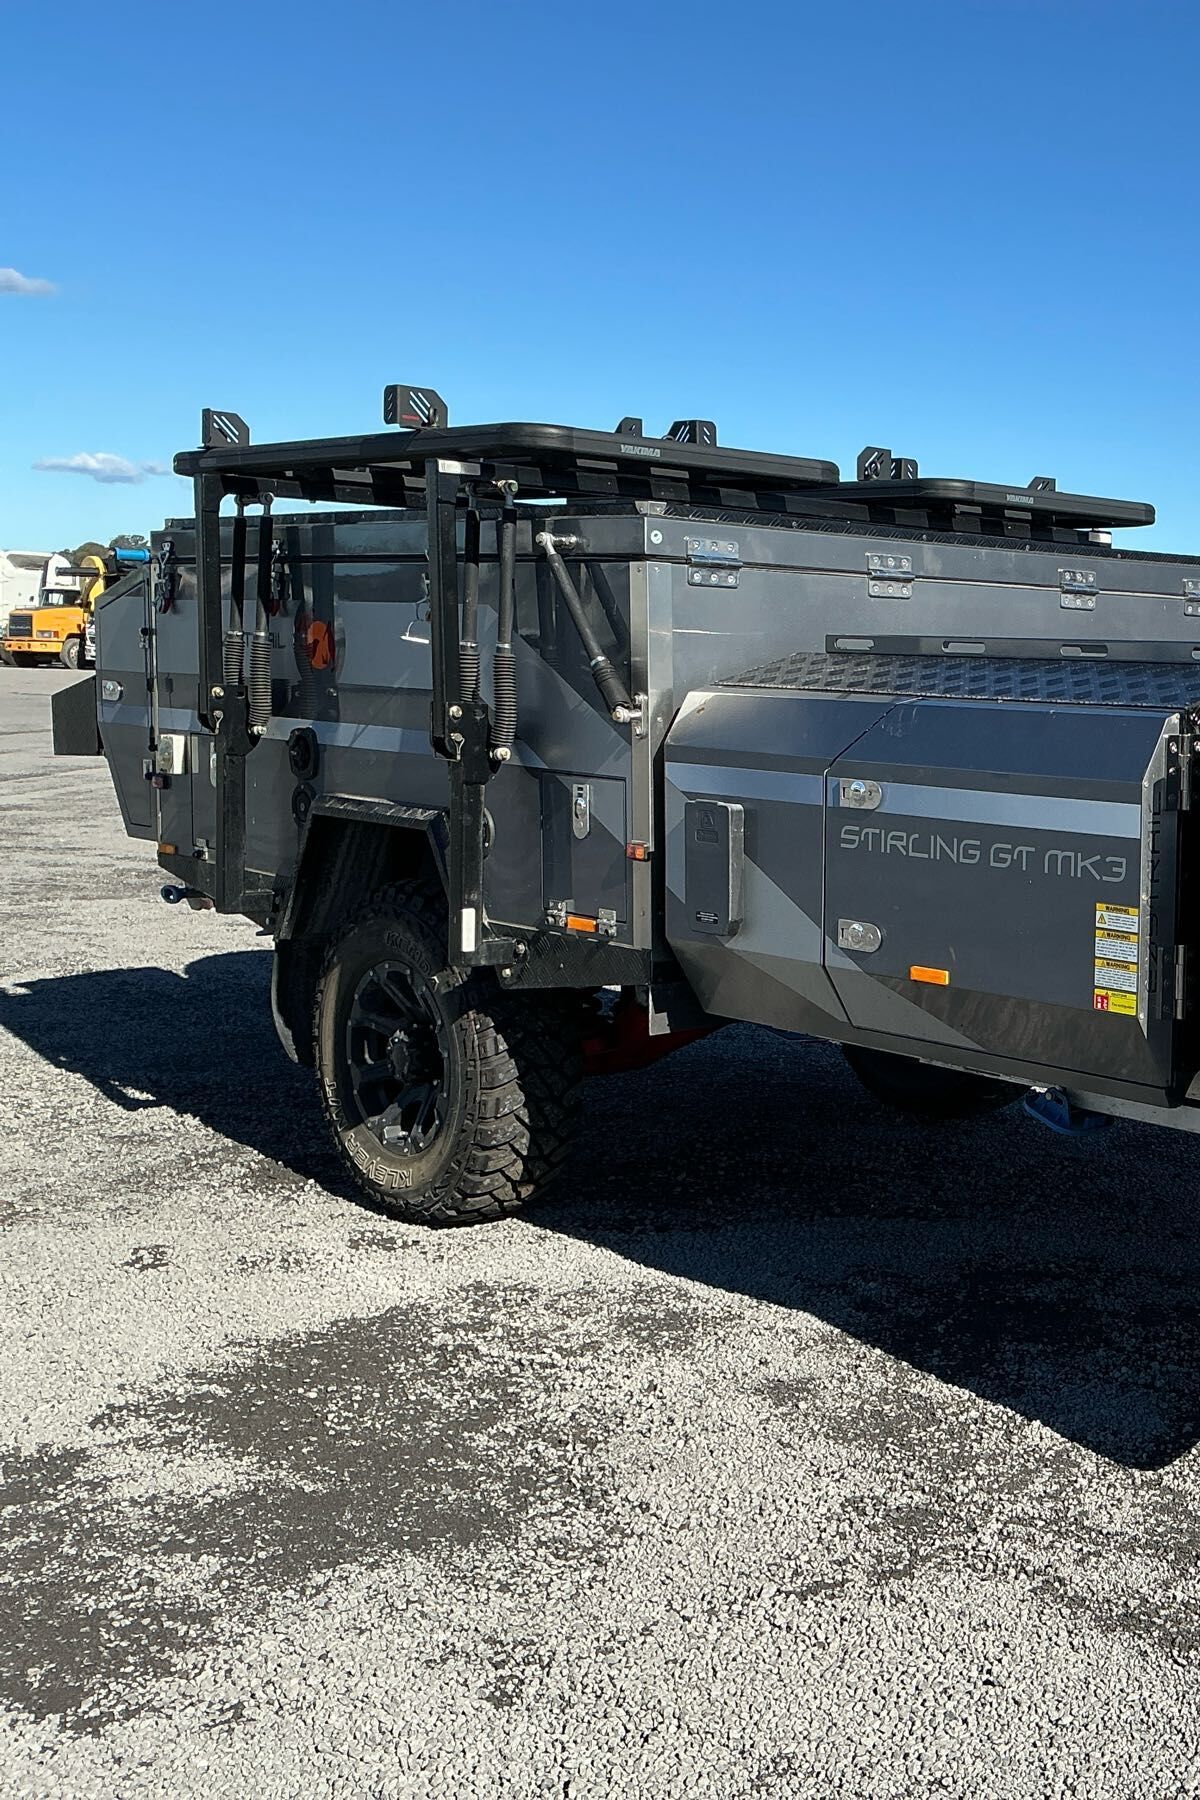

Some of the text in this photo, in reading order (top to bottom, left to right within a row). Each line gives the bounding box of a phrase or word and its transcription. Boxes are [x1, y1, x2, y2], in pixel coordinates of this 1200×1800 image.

[620, 444, 661, 458] YAKIMA
[1005, 493, 1034, 504] YAKIMA
[840, 825, 1127, 883] STIRLING GT MK3
[1105, 905, 1130, 915] WARNING
[1106, 932, 1131, 941] WARNING
[1105, 961, 1131, 971] WARNING
[344, 1133, 413, 1188] KLEVER
